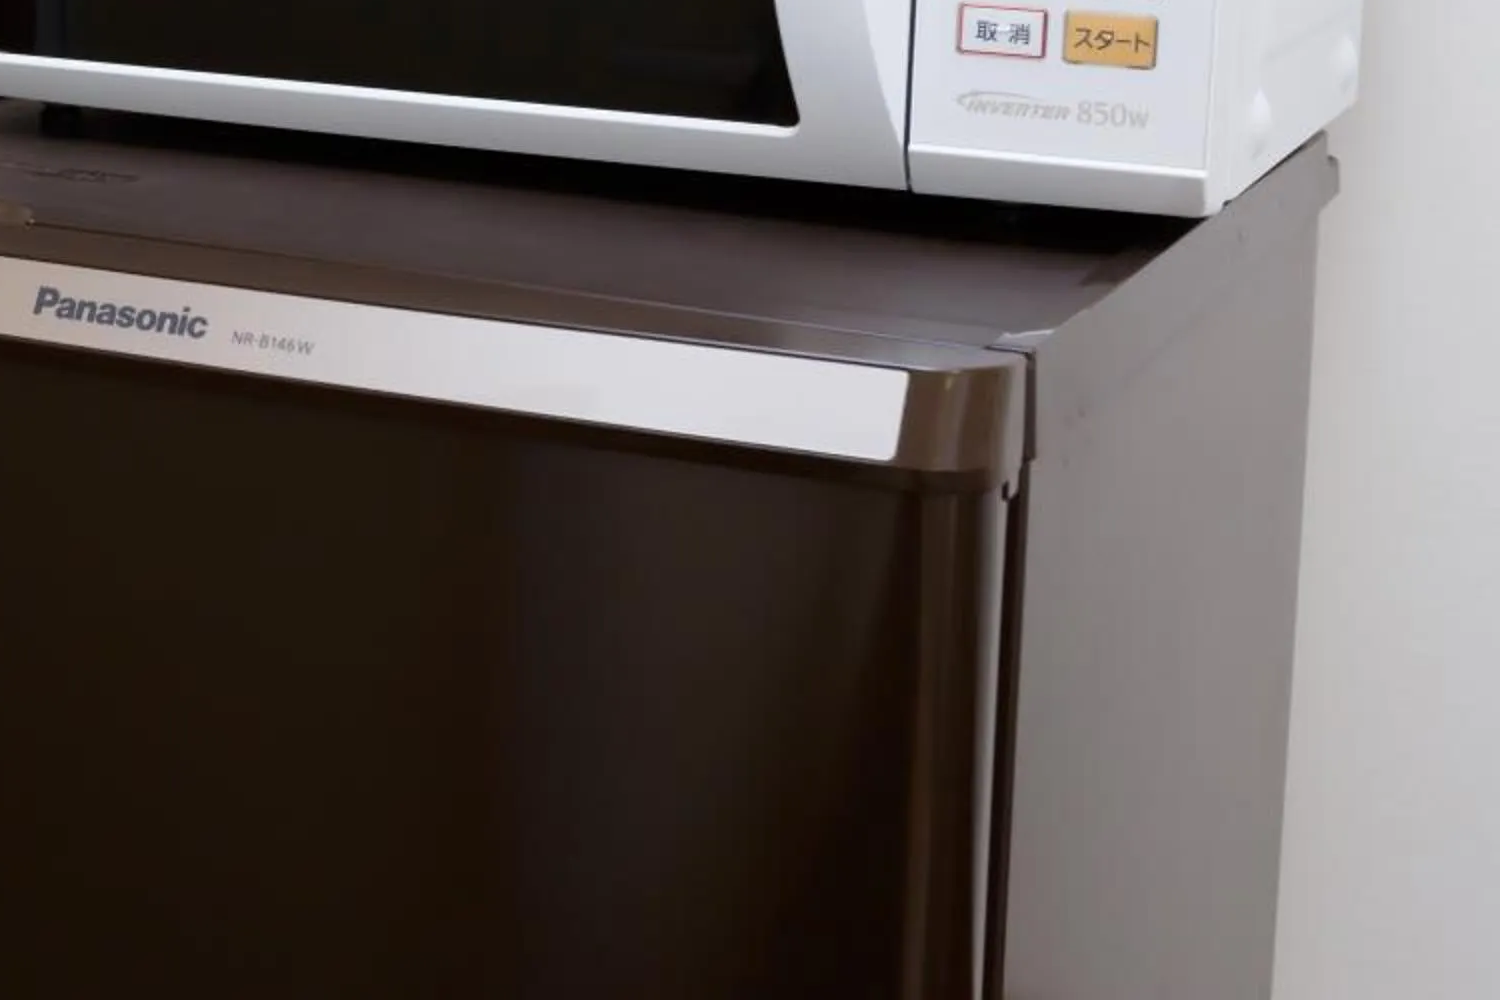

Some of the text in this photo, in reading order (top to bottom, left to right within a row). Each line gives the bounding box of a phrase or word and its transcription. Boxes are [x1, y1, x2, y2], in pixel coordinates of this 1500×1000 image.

[1074, 27, 1150, 53] スタート
[964, 98, 1072, 121] INVERTER
[33, 285, 208, 339] Panasonic
